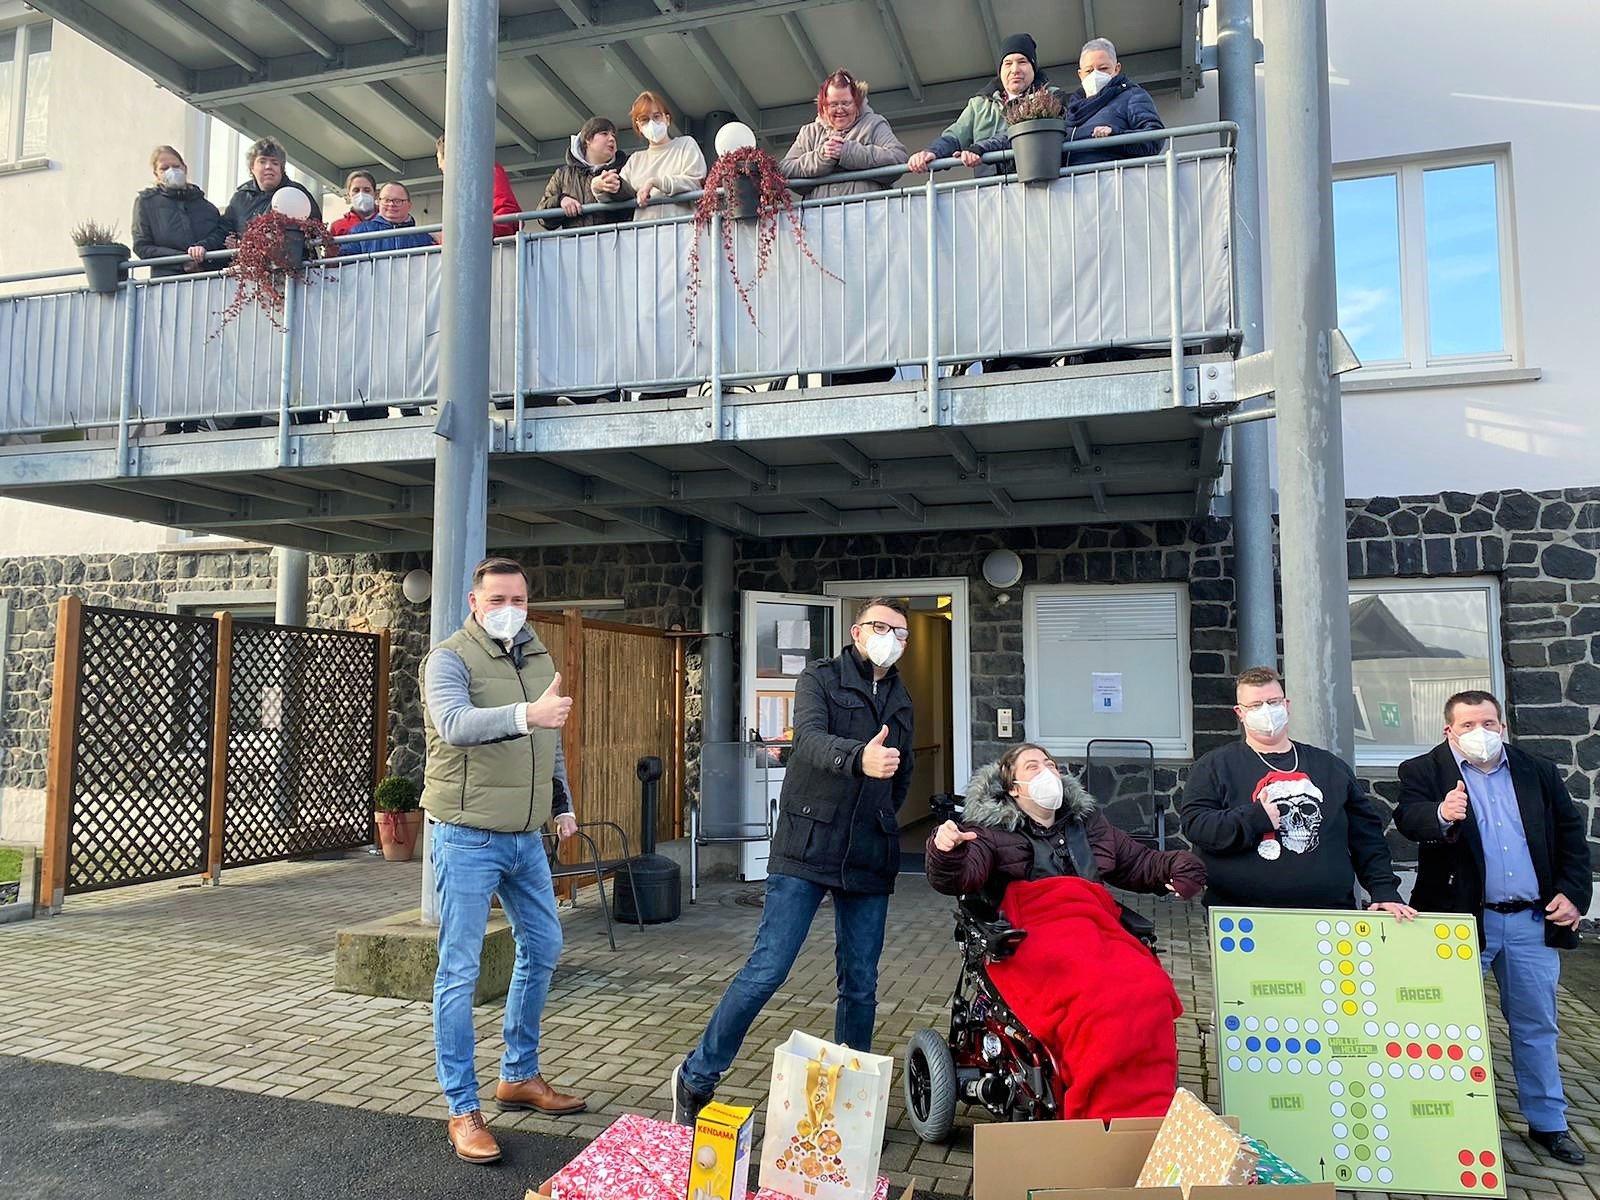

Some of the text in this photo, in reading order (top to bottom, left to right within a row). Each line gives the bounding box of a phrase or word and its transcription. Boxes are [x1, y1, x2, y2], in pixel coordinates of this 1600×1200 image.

[1253, 983, 1304, 996] MENSCH
[1400, 986, 1441, 1000] ÄRGER
[1271, 1096, 1302, 1109] DICH
[1412, 1103, 1451, 1116] NICHT
[698, 1125, 735, 1141] KENDAMA
[1340, 1169, 1347, 1178] A
